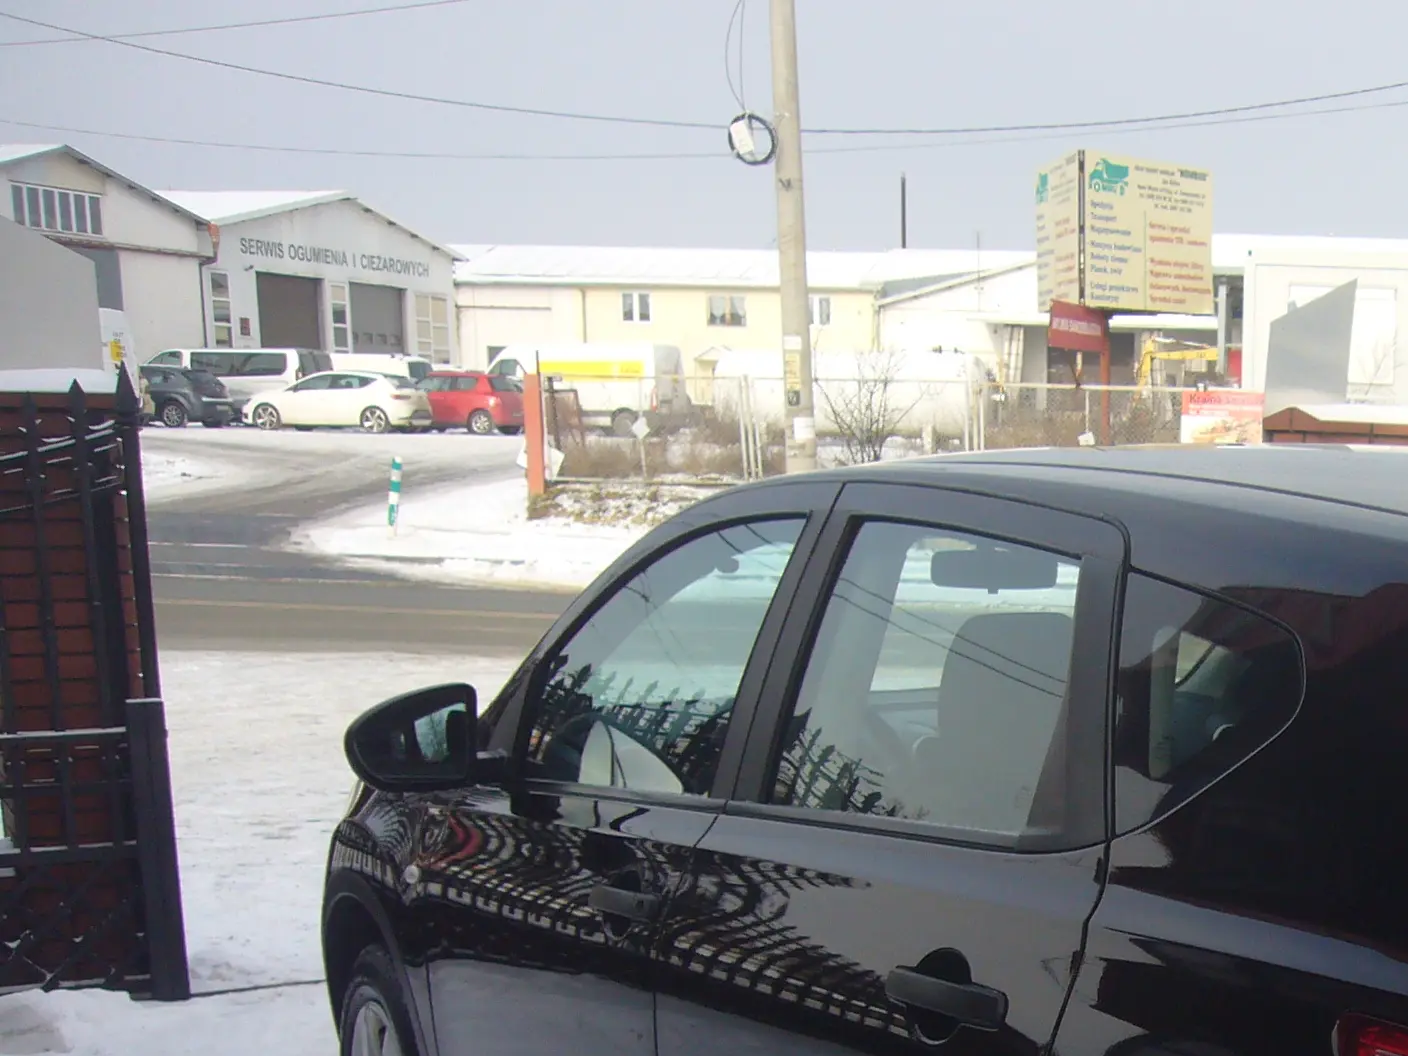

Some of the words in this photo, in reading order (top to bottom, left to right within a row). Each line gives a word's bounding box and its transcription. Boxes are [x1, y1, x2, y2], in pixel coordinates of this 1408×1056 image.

[240, 237, 284, 259] SERWIS
[288, 243, 349, 267] OGUMIENIA
[352, 255, 357, 268] I
